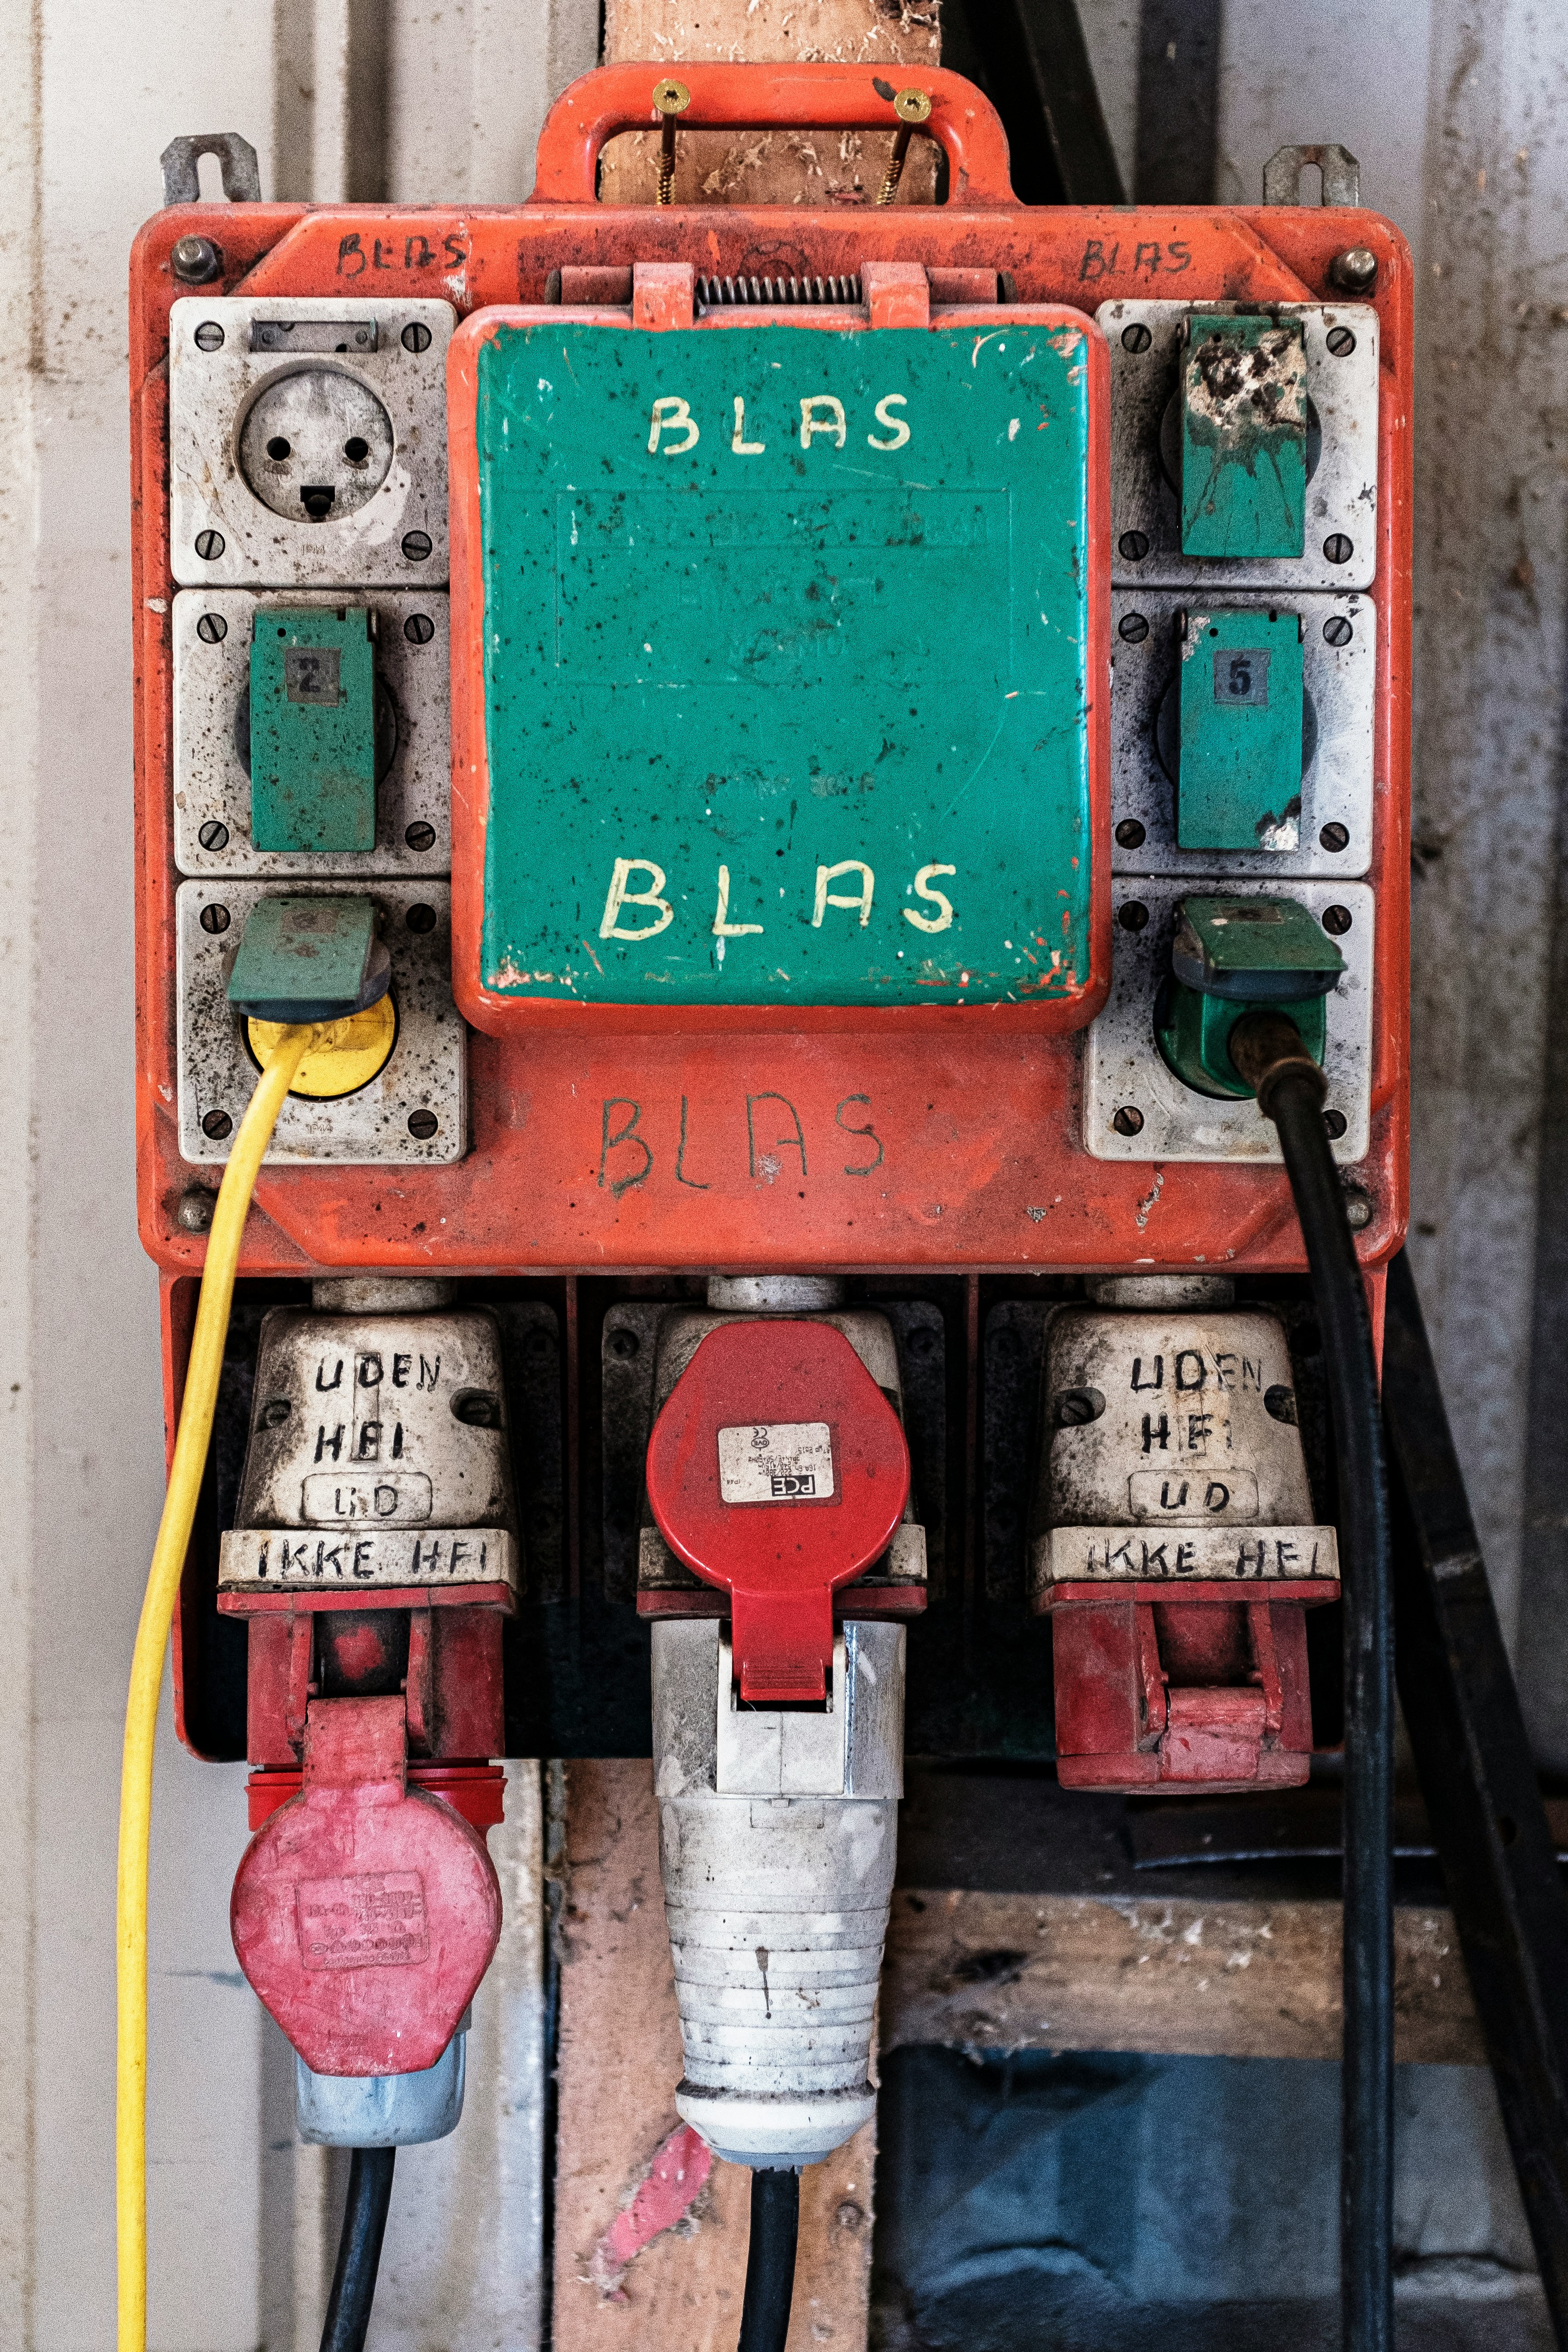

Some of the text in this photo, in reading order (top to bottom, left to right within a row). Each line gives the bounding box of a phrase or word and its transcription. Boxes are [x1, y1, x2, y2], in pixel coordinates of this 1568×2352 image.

[335, 232, 468, 279] BLAS
[1079, 240, 1193, 283] BLAS
[647, 393, 911, 455] BLAS
[1228, 655, 1252, 696] 5
[599, 856, 957, 941] BLAS
[598, 1091, 885, 1200] BLAS
[315, 1352, 441, 1392] UDEN
[1130, 1349, 1262, 1393] UDEN
[773, 1476, 814, 1495] PCE
[1160, 1481, 1230, 1513] UD
[257, 1539, 487, 1579] IKKE HFI
[1086, 1536, 1319, 1577] IKKE HFI
